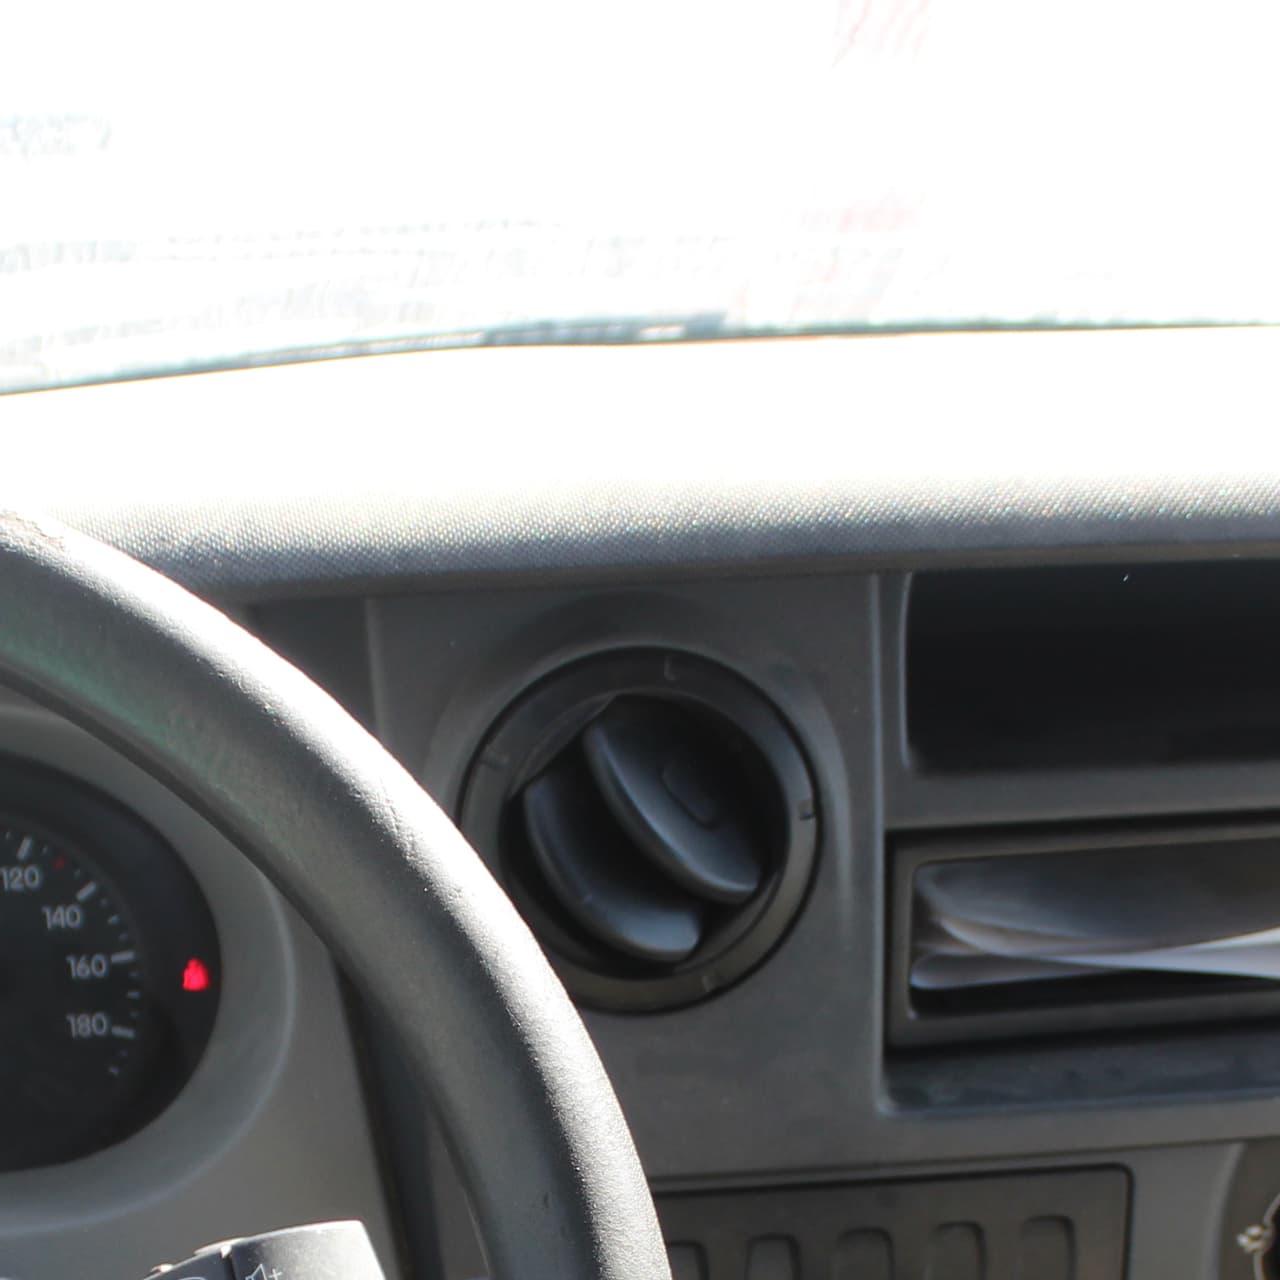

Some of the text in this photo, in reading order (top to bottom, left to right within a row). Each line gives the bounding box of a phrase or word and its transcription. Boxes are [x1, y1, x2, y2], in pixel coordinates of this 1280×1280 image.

[0, 865, 42, 889] 120
[42, 906, 83, 929] 140
[66, 954, 109, 978] 160
[66, 1013, 110, 1037] 180
